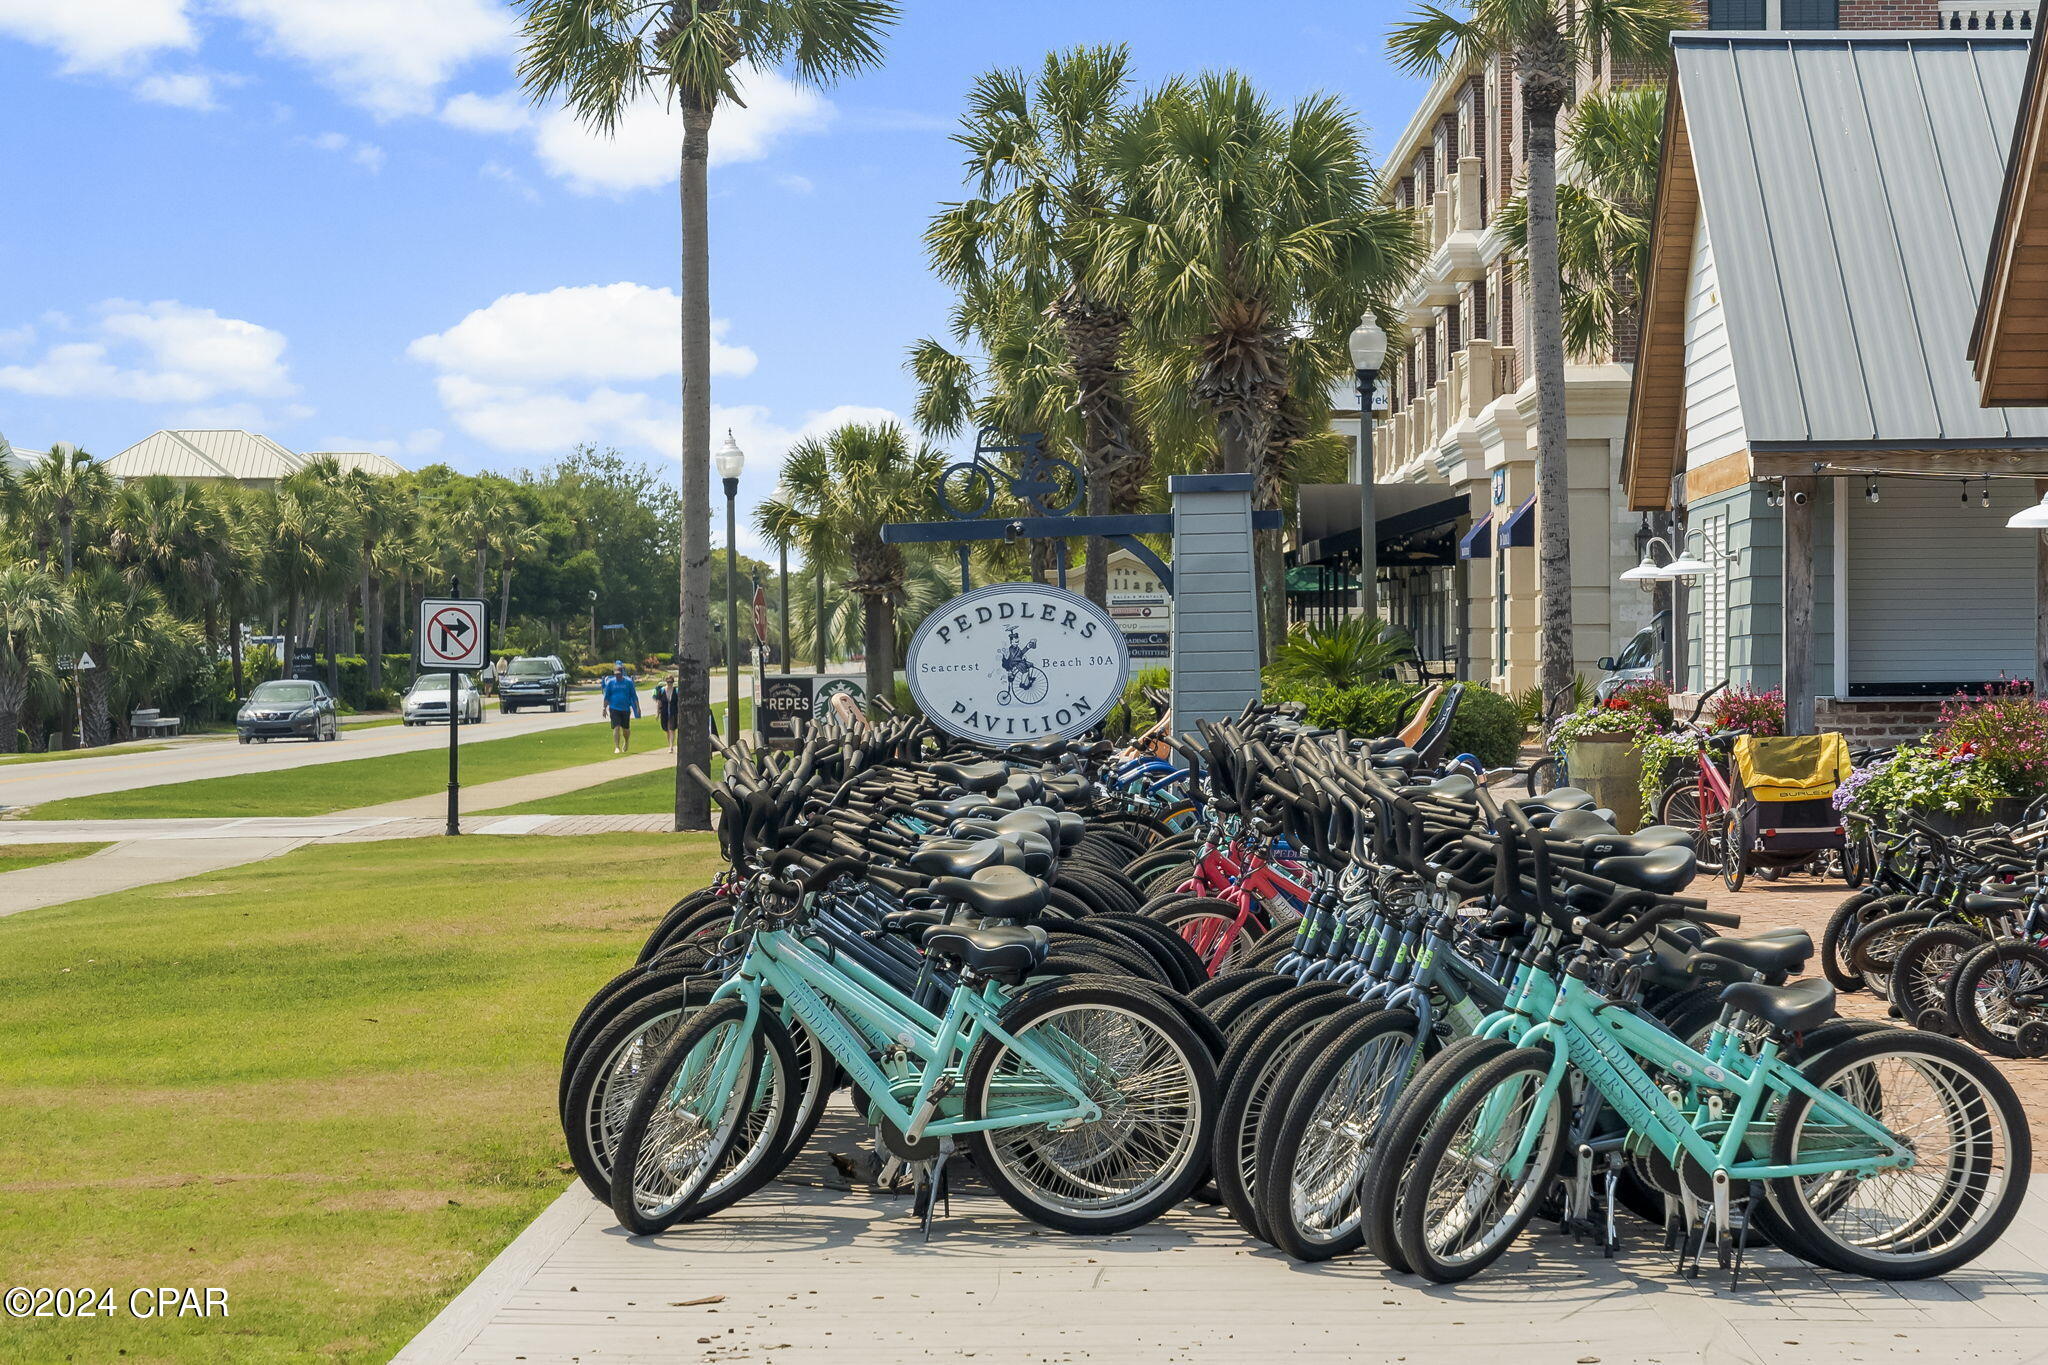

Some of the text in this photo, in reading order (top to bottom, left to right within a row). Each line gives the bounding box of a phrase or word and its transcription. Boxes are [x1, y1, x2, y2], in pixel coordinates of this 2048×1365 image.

[1107, 579, 1165, 593] llage
[936, 602, 1097, 645] PEDDLERS
[921, 655, 1114, 673] Seacrest Beach 30A
[767, 697, 809, 710] REPES
[951, 696, 1092, 734] PAVILION
[1780, 789, 1830, 798] BURLEY
[1593, 844, 1613, 853] C9
[1700, 962, 1718, 971] C9
[786, 989, 851, 1064] PEDDLERS
[1590, 1026, 1660, 1107] PEDDLERS
